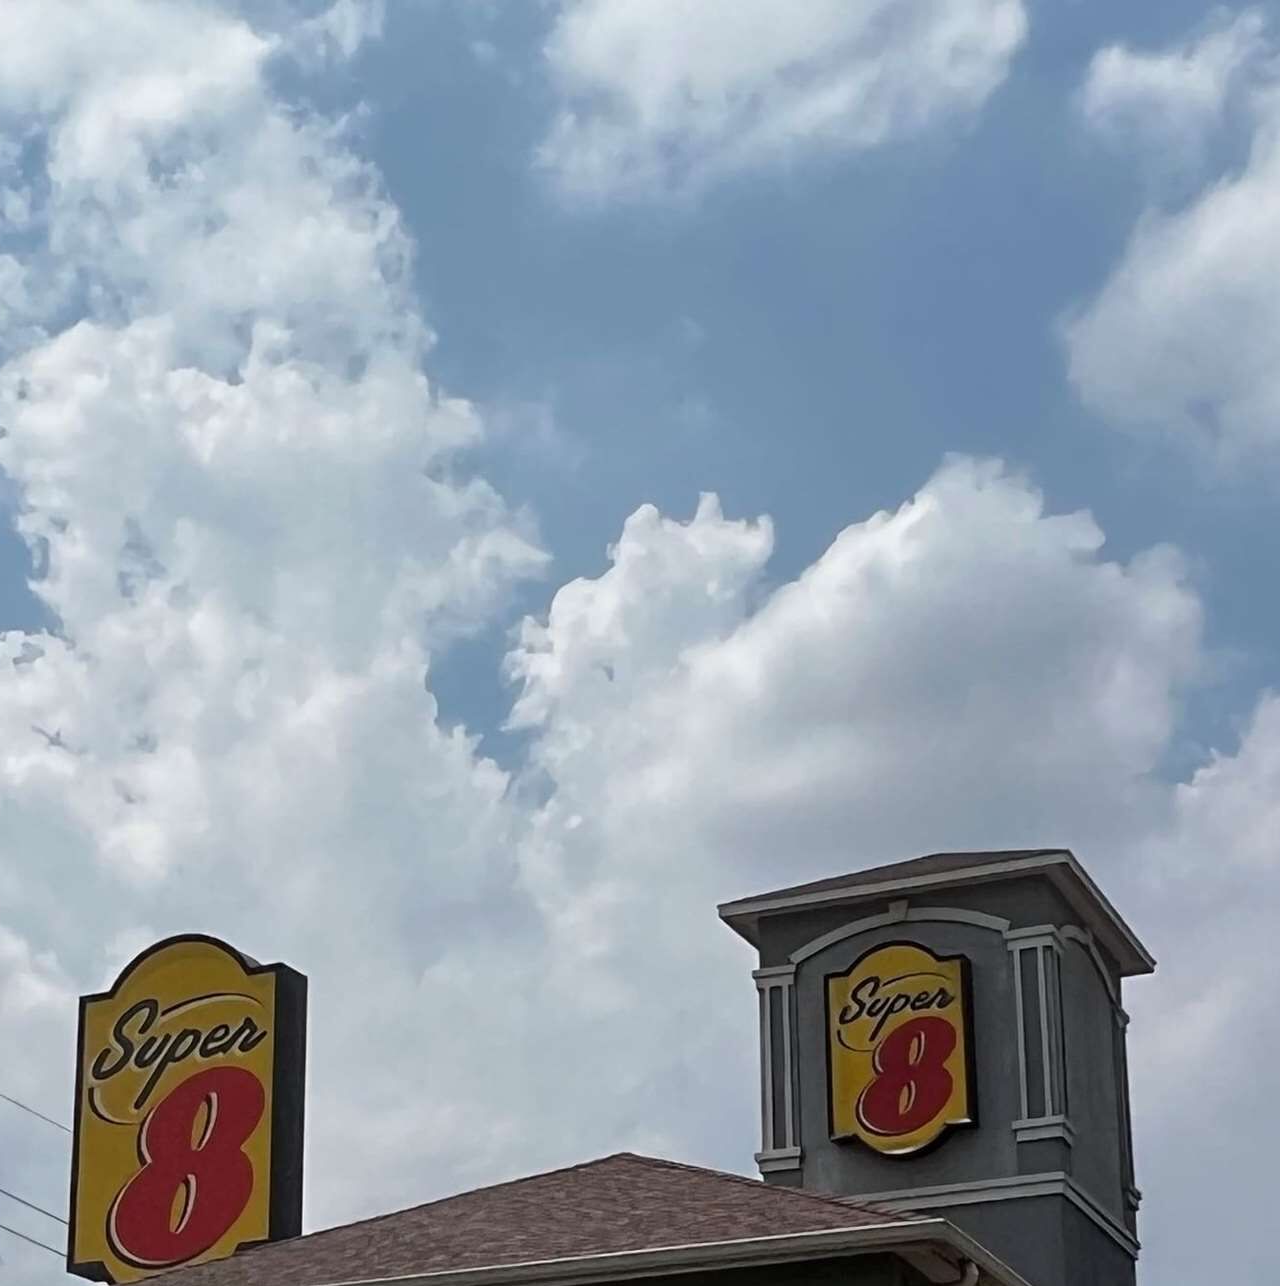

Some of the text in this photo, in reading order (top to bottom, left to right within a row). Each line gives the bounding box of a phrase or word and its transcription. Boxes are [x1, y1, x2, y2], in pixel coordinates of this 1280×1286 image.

[91, 998, 267, 1111] Super
[838, 976, 955, 1042] Super
[855, 1016, 957, 1137] 8
[106, 1066, 266, 1269] 8
